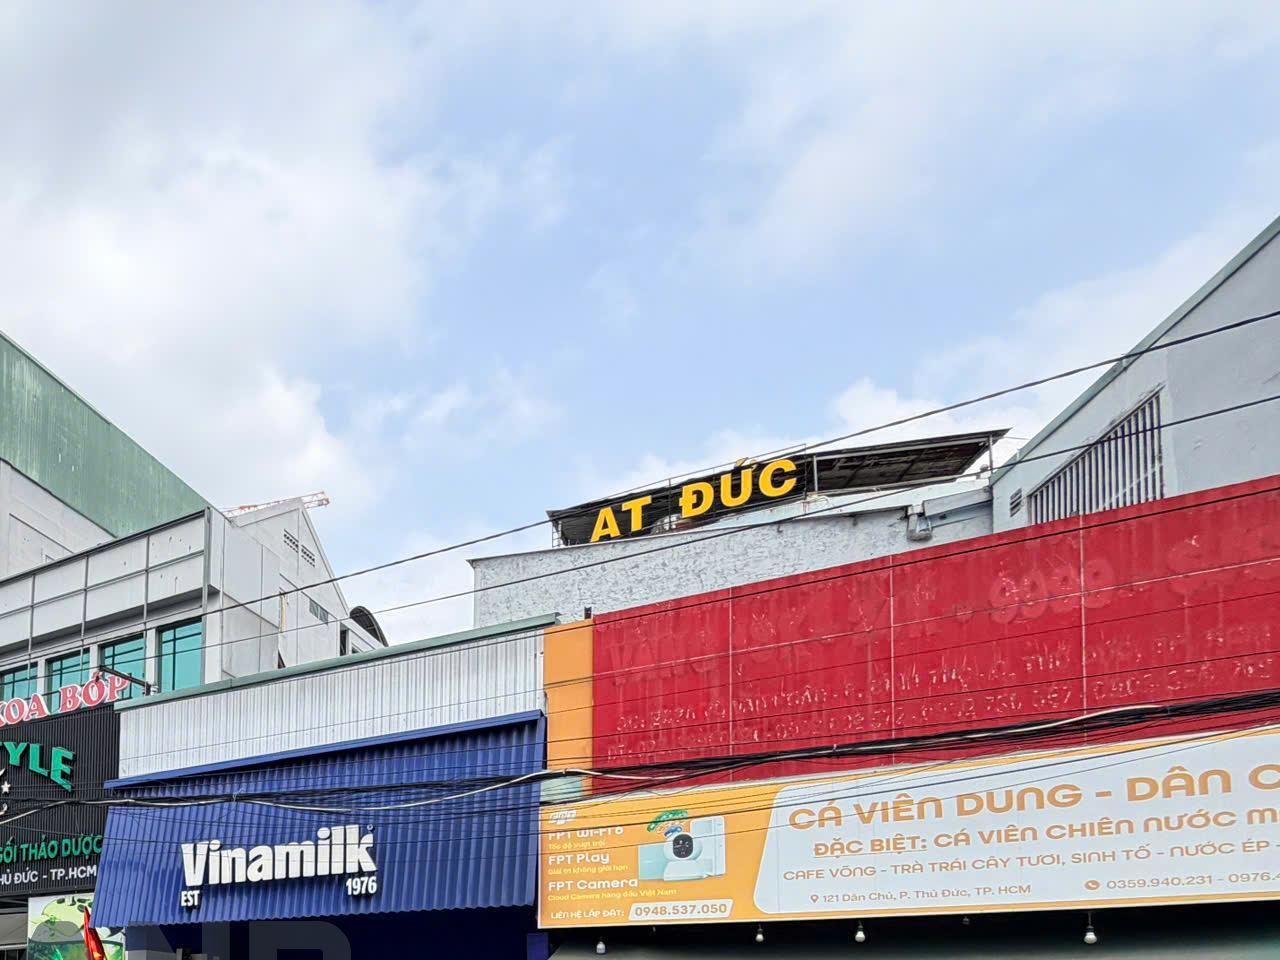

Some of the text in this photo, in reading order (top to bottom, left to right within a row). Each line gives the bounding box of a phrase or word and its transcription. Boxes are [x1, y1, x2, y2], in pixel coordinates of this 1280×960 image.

[590, 457, 797, 543] AT ĐỨC
[789, 799, 843, 830] CÁ
[853, 793, 944, 825] VIÊN
[956, 783, 1083, 816] DUNG
[1126, 765, 1233, 801] DÂN
[20, 834, 59, 861] THẢO
[61, 833, 103, 860] DƯỢC
[813, 838, 864, 858] ĐẶC
[870, 833, 928, 854] BIỆT:
[933, 828, 971, 848] CÁ
[978, 824, 1038, 844] VIÊN
[1045, 816, 1134, 840] CHIÊN
[1143, 809, 1237, 833] NƯỚC
[181, 824, 378, 887] Vinamilk
[548, 852, 610, 865] FPT Play
[783, 869, 825, 881] CAFE
[829, 865, 877, 878] VÕNG
[891, 860, 924, 875] TRÀ
[928, 858, 967, 872] TRÁI
[971, 855, 1011, 870] CÂY
[1071, 850, 1117, 864] SINH
[1122, 843, 1152, 860] TỐ
[1171, 840, 1236, 857] NƯỚC
[1242, 838, 1270, 853] ÉP
[13, 867, 39, 885] ĐỨC
[548, 879, 639, 891] FPT Camera
[1106, 875, 1213, 890] 0359.940.231
[181, 876, 378, 907] EST 1976
[823, 894, 840, 903] 121
[842, 893, 866, 902] Dân
[913, 889, 939, 899] Thủ
[998, 884, 1031, 895] HCM
[634, 903, 728, 917] 0948.537.050
